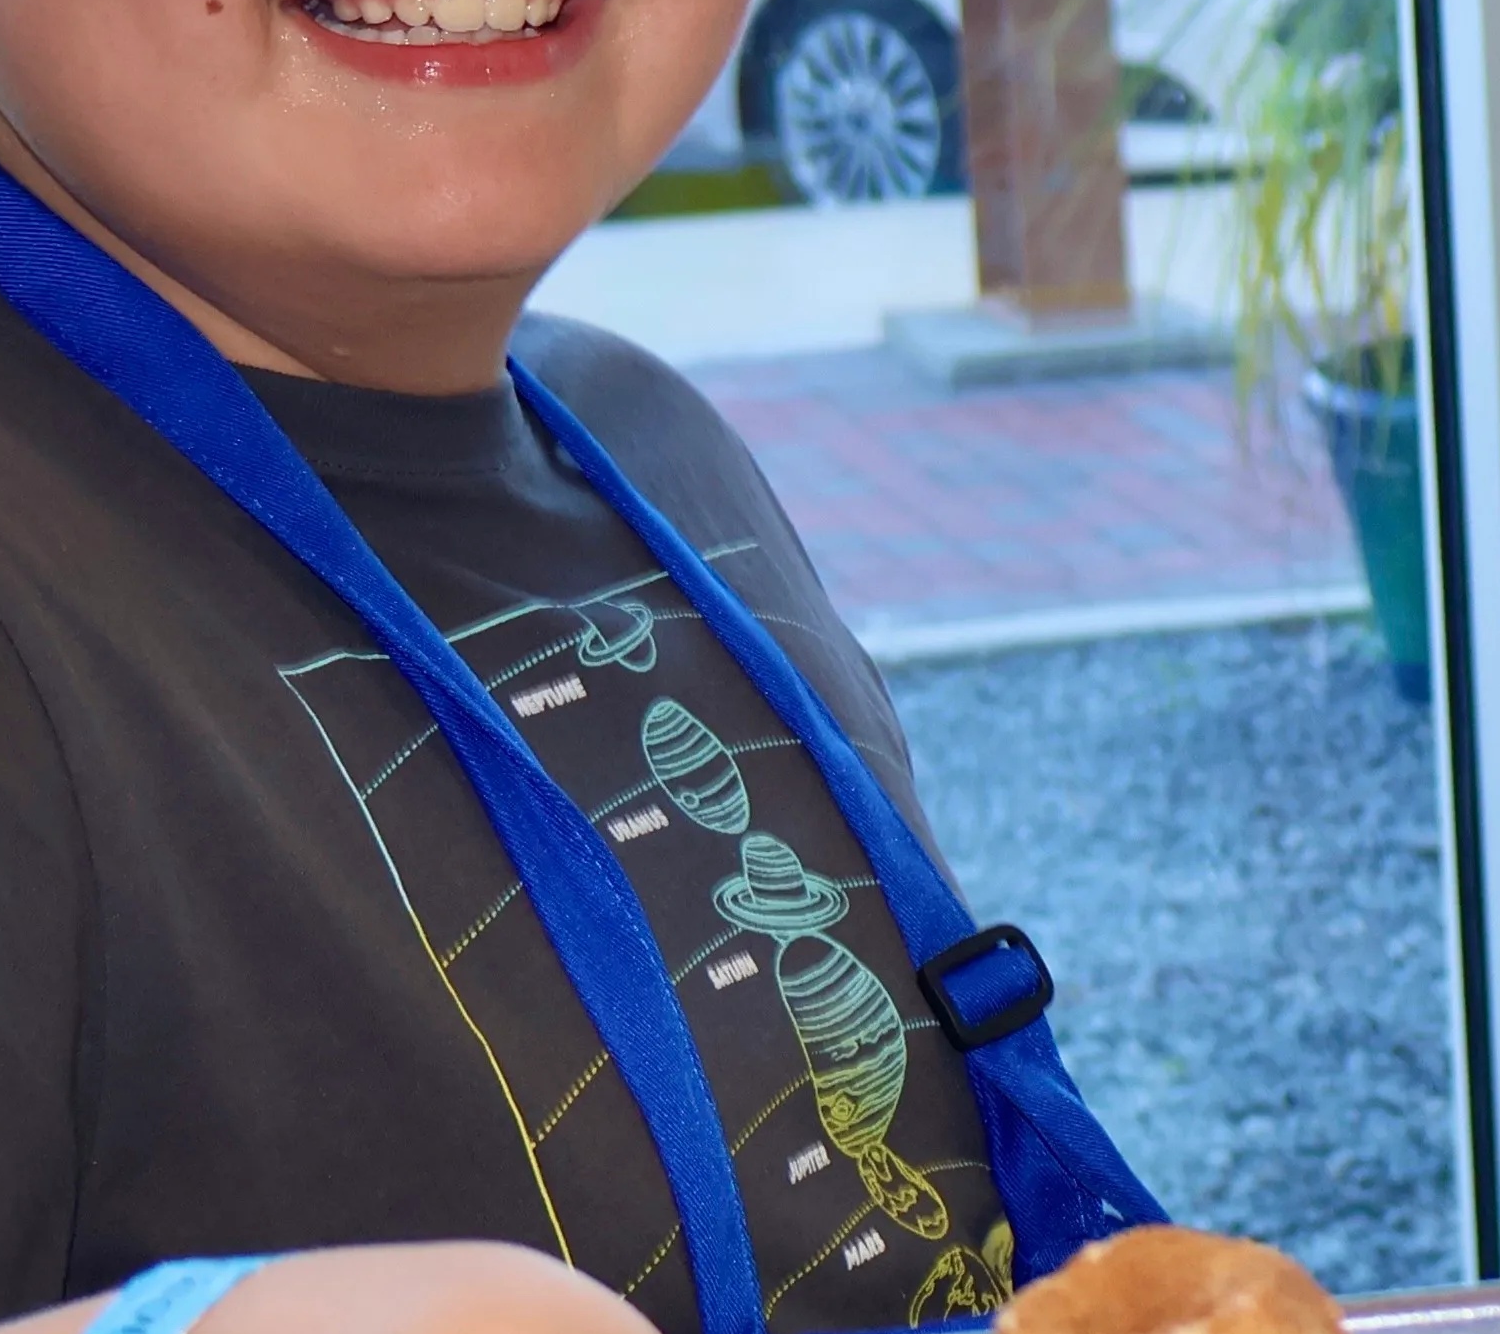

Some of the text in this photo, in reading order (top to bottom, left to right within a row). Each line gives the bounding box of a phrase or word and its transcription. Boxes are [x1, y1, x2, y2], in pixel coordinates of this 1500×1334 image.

[510, 673, 588, 718] NEPTUNE
[606, 804, 670, 843] URANUS
[706, 950, 759, 990] SATURN
[788, 1140, 831, 1186] JUPITER
[843, 1227, 886, 1271] MARS
